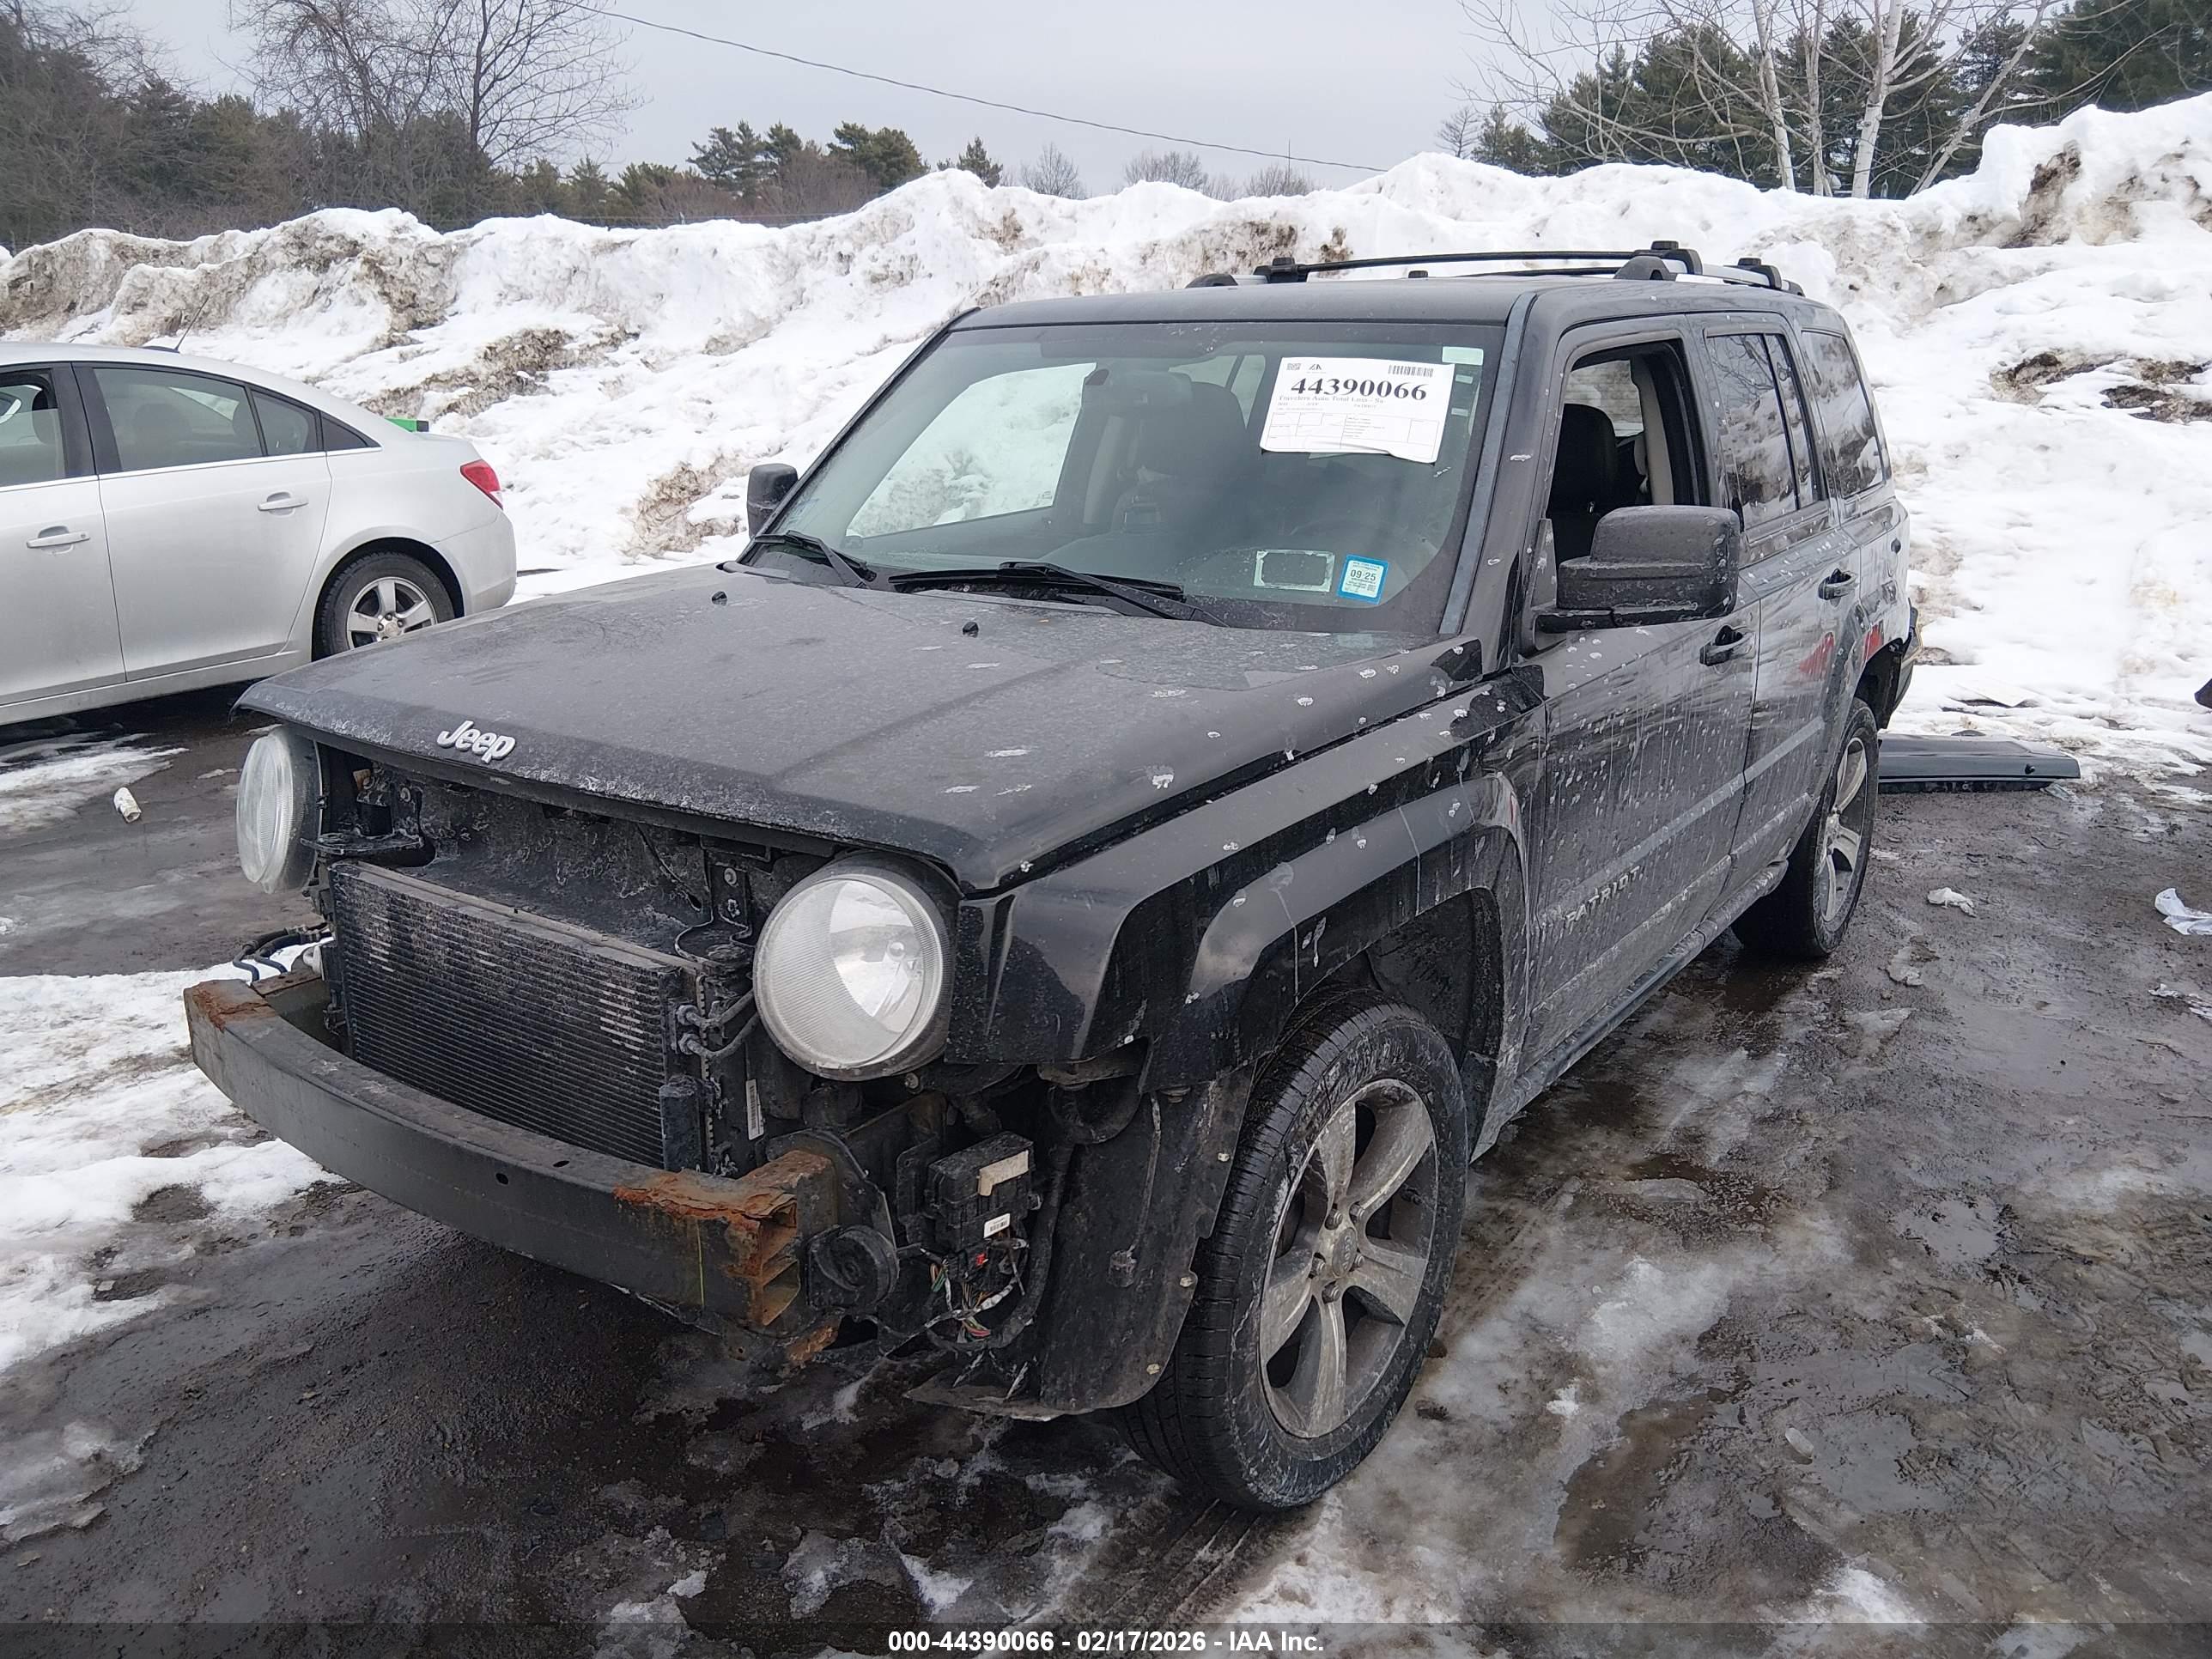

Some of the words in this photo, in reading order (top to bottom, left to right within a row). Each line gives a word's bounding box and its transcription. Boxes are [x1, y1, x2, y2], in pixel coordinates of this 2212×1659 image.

[1291, 378, 1429, 401] 44390066
[1350, 569, 1362, 578] 09
[1364, 572, 1376, 580] 25
[436, 720, 516, 763] Jeep
